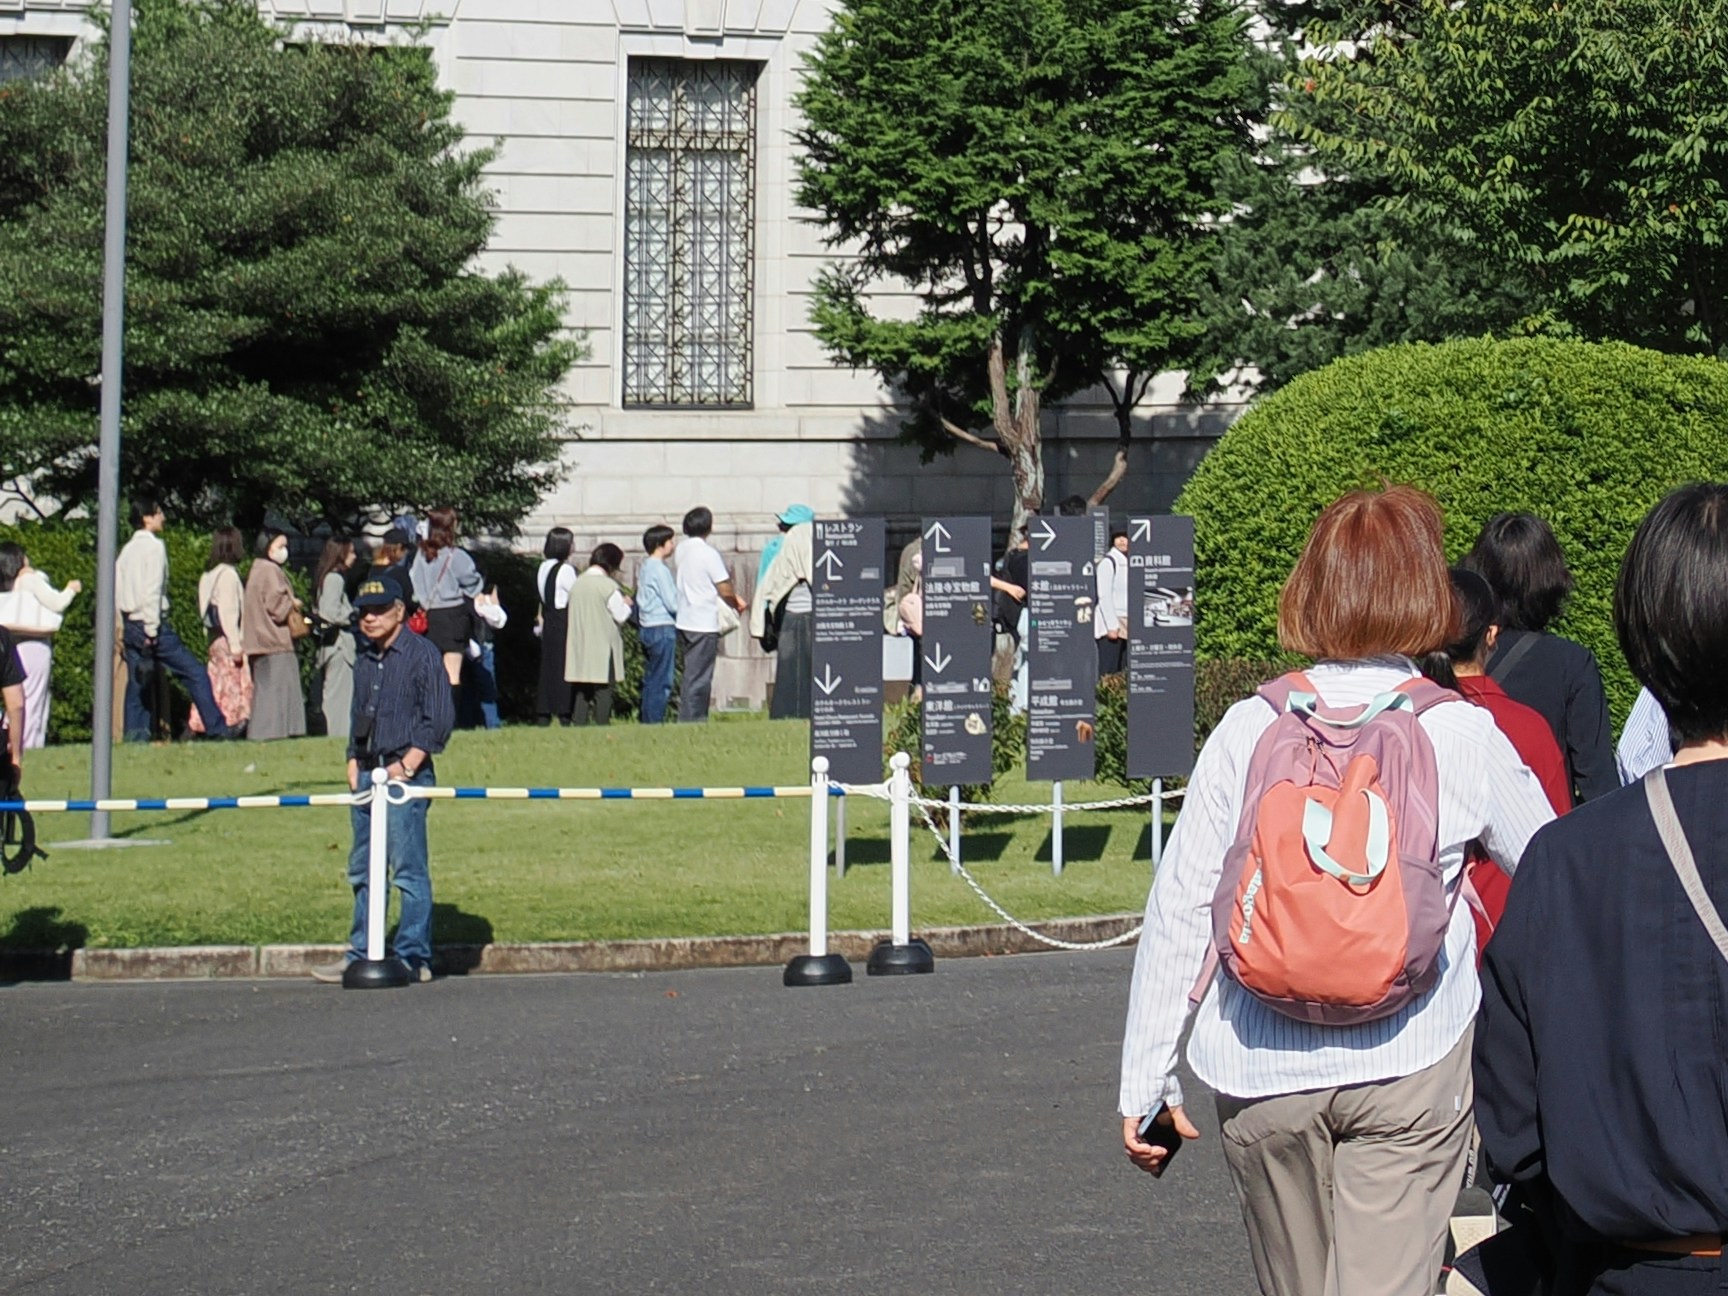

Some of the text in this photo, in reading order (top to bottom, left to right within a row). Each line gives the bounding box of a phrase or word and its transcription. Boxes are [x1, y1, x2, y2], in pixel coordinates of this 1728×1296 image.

[824, 522, 863, 533] レストラン
